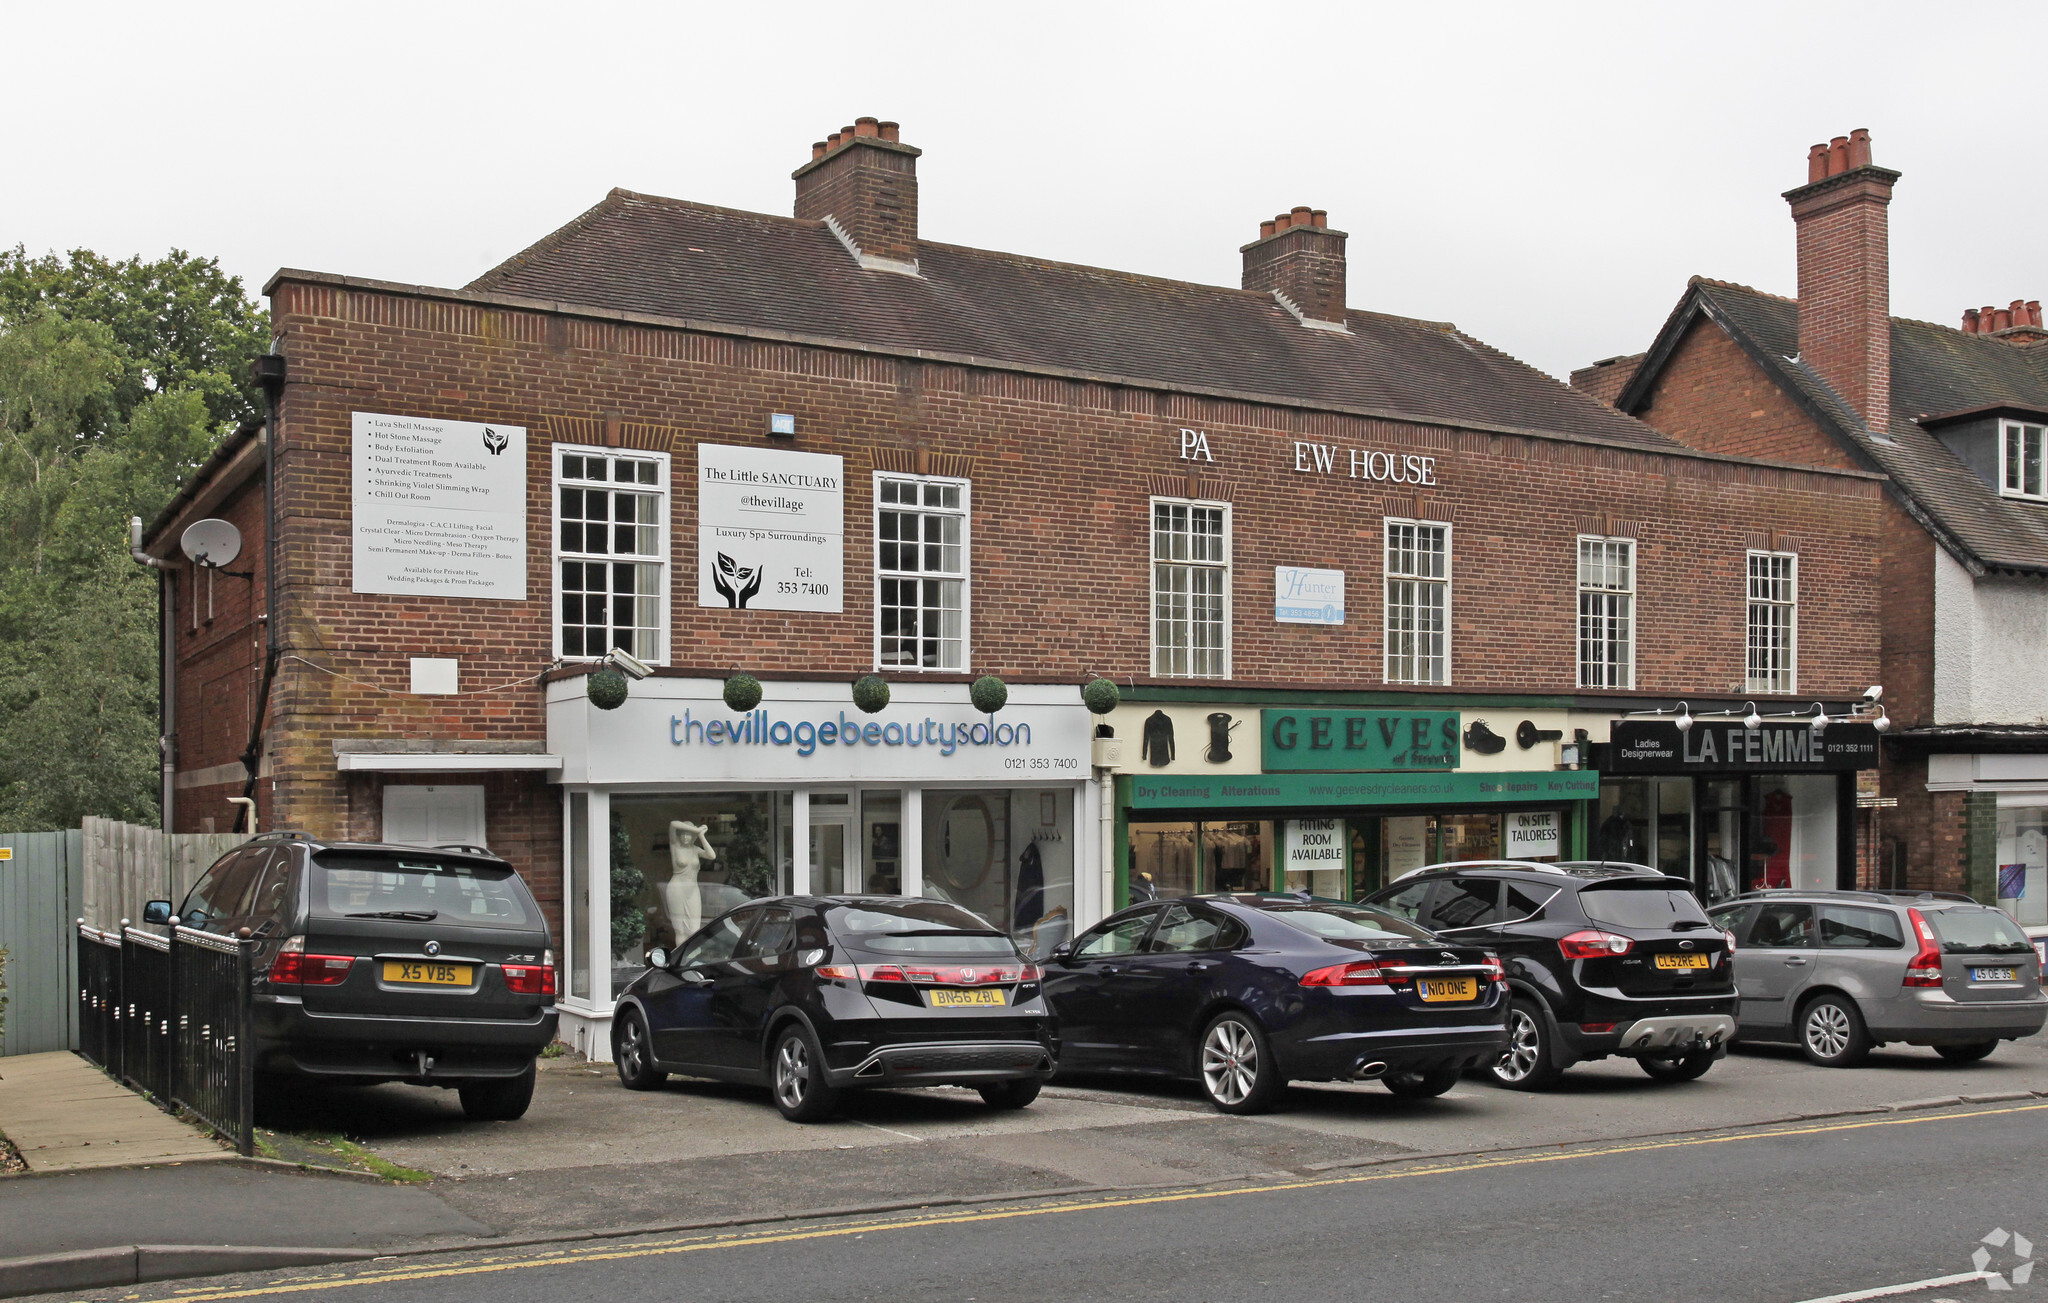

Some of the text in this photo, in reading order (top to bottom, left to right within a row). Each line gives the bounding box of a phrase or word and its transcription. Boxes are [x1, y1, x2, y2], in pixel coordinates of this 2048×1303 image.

[375, 420, 391, 428] Lava
[414, 424, 443, 432] Massage
[412, 435, 442, 444] Massage
[375, 444, 433, 454] Body Exfoliation
[395, 457, 430, 466] Treatment
[432, 460, 452, 468] Room
[454, 462, 486, 470] Available
[1350, 449, 1436, 485] HOUSE
[375, 468, 452, 479] Ayurvedic Treatments
[705, 468, 837, 488] The Little SANCTUARY
[375, 479, 411, 489] Shrinking
[436, 483, 470, 493] Slimming
[472, 486, 490, 494] Wrap
[741, 496, 803, 512] @thevillage
[387, 519, 425, 527] Dermalogica
[453, 523, 474, 531] Lifting
[472, 534, 494, 542] Oxygen
[716, 528, 826, 544] Luxury Spa Surroundings
[385, 547, 418, 555] Permanent
[464, 542, 488, 550] Therapy
[794, 567, 812, 577] Tel:
[777, 582, 828, 595] 353 7400
[1281, 570, 1336, 599] Hunter
[670, 708, 1031, 756] thevillagebeautysalon
[1272, 715, 1457, 751] GEEVES
[1635, 739, 1660, 749] Ladies
[1684, 729, 1824, 762] LA FEMME
[1828, 744, 1873, 752] 0121 352 1111
[1622, 749, 1673, 759] Designerwear
[1004, 758, 1078, 769] 0121 353 7400
[1139, 786, 1158, 799] Dry
[1161, 785, 1210, 799] Cleaning
[1221, 785, 1281, 797] Alterations
[1308, 782, 1455, 797] www.geevesdrycleaners.co.uk
[1479, 781, 1502, 794] Shoe
[1548, 781, 1563, 794] Key
[1565, 779, 1596, 793] Cutting
[1300, 819, 1334, 830] FITTING
[1518, 815, 1550, 827] ON SITE
[1303, 834, 1331, 845] ROOM
[1512, 829, 1557, 842] TAILORESS
[1292, 849, 1342, 860] AVAILABLE
[401, 964, 422, 979] X5
[1977, 968, 1986, 979] 45
[2003, 969, 2011, 979] 35
[937, 991, 999, 1004] BN56 ZBL
